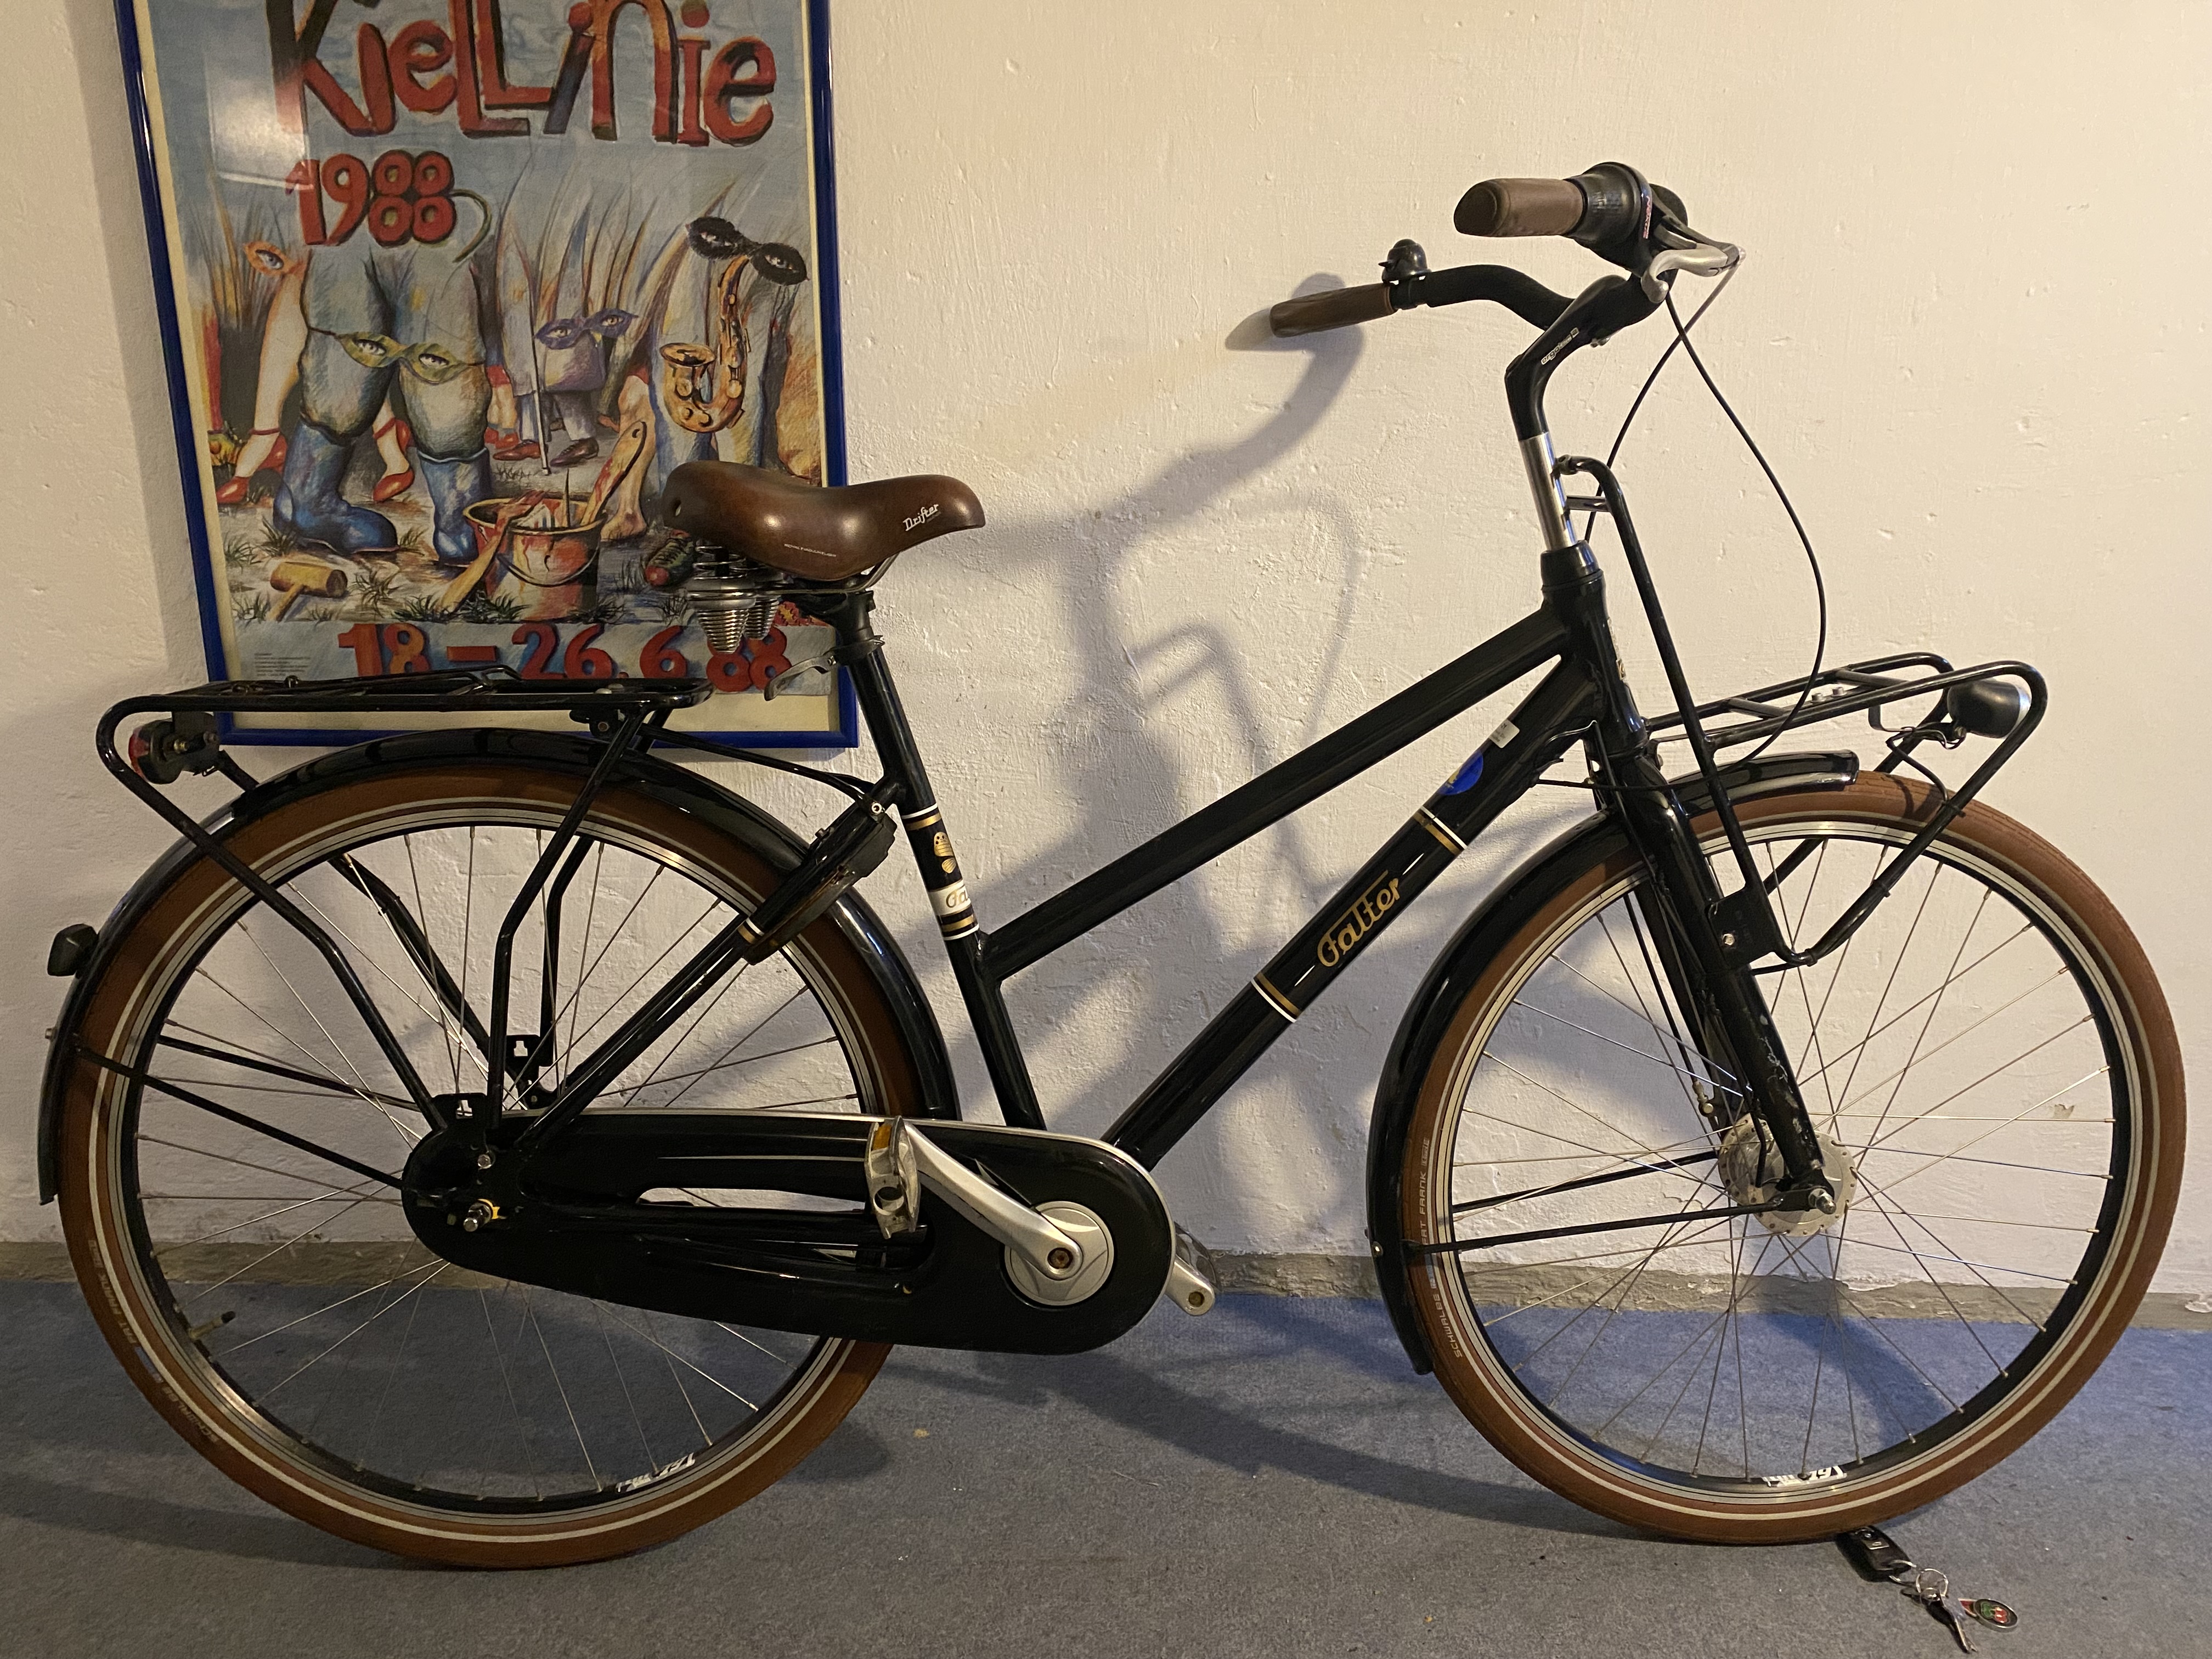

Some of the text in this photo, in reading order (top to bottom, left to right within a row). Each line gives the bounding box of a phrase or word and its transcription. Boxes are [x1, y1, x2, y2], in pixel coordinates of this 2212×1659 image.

[285, 149, 457, 247] 1988
[902, 504, 939, 532] Drifter
[337, 623, 431, 677] 18
[1317, 870, 1400, 967] Falter
[1419, 1171, 1427, 1215] FRANK
[1433, 1293, 1463, 1358] SCHWALBE
